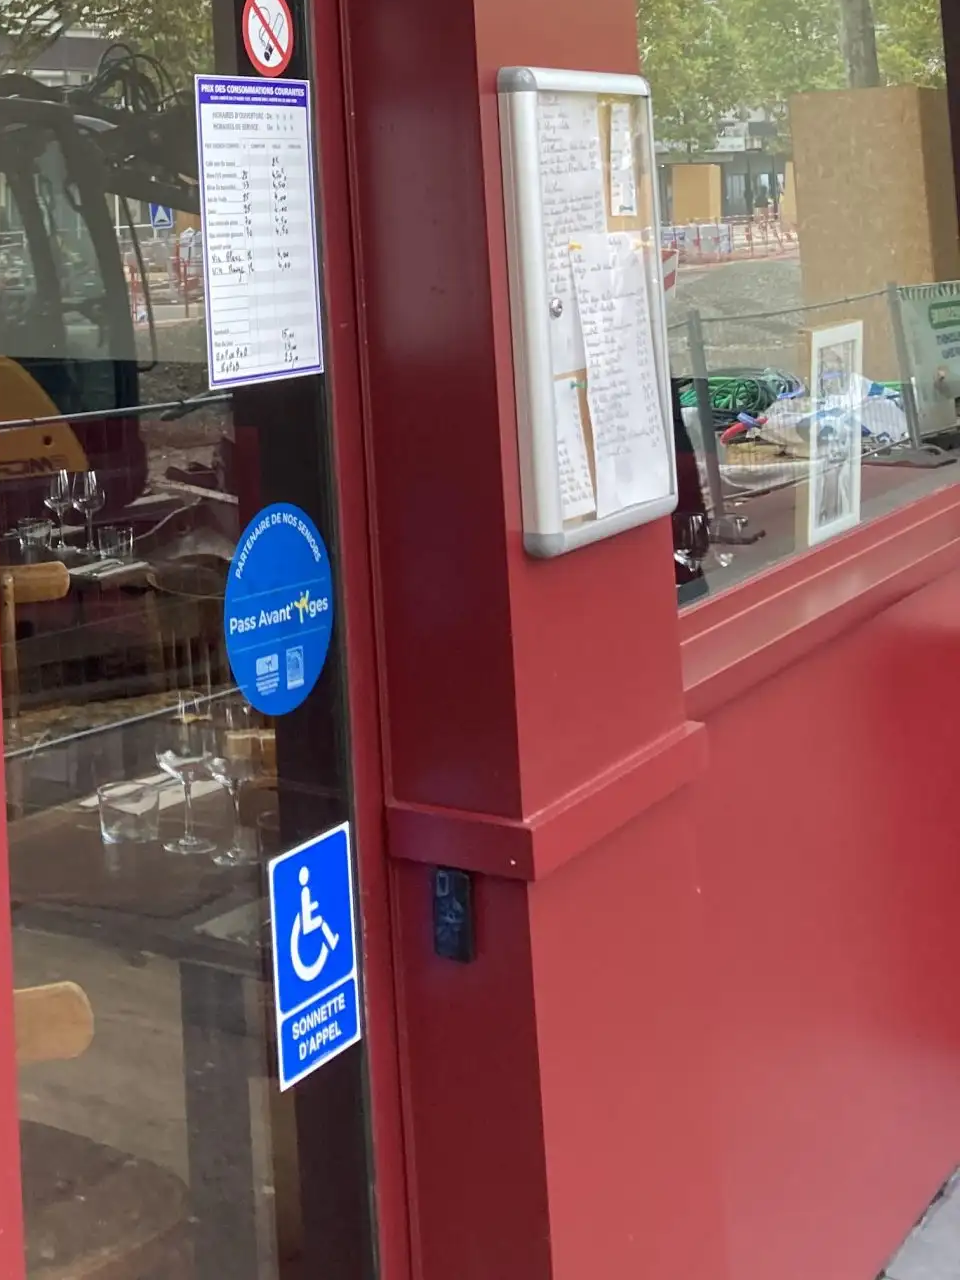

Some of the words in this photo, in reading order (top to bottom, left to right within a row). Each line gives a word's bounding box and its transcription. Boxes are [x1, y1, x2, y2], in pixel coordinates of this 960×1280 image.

[200, 84, 215, 93] PRIX
[215, 84, 226, 93] DES
[226, 85, 274, 96] CONSOMMATIONS
[274, 87, 305, 97] COURANTES
[235, 516, 270, 579] PARTENAIRE
[271, 512, 282, 525] DE
[282, 512, 298, 527] NOS
[297, 519, 321, 562] SENIORS
[229, 615, 256, 635] Pass
[292, 992, 346, 1040] SONNETTE
[299, 1020, 342, 1061] D'APPEL
